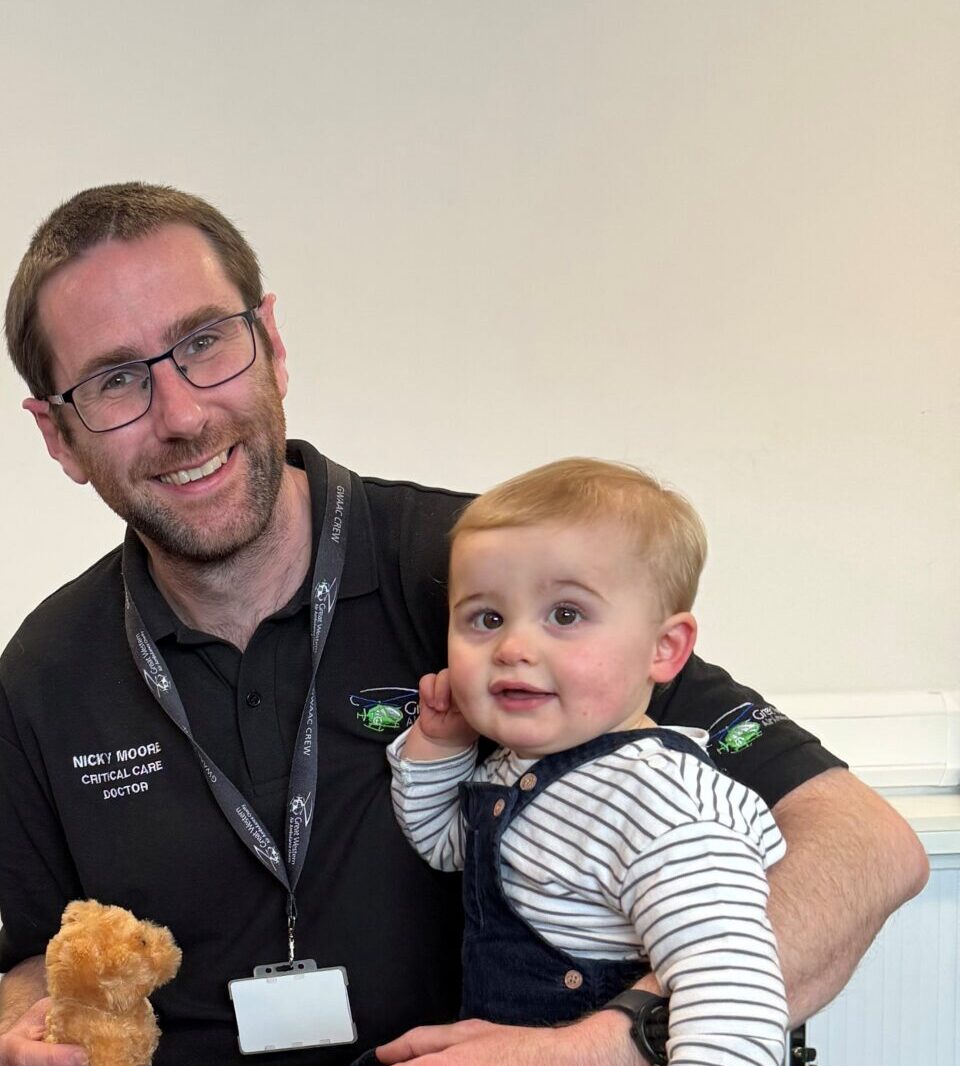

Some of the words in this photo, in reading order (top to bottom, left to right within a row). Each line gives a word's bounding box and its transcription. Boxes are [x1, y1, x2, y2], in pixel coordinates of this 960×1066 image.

[334, 485, 345, 517] GWAAC
[330, 516, 342, 543] CREW
[134, 632, 149, 657] Western
[144, 655, 158, 676] Great
[302, 727, 312, 756] CREW
[72, 752, 112, 769] NICKY
[116, 742, 162, 763] MOORE
[81, 768, 132, 785] CRITICAL
[131, 760, 163, 776] CARE
[103, 781, 149, 800] DOCTOR
[235, 806, 255, 832] Western
[292, 816, 302, 836] Great
[250, 829, 267, 848] Great
[290, 837, 300, 865] Western
